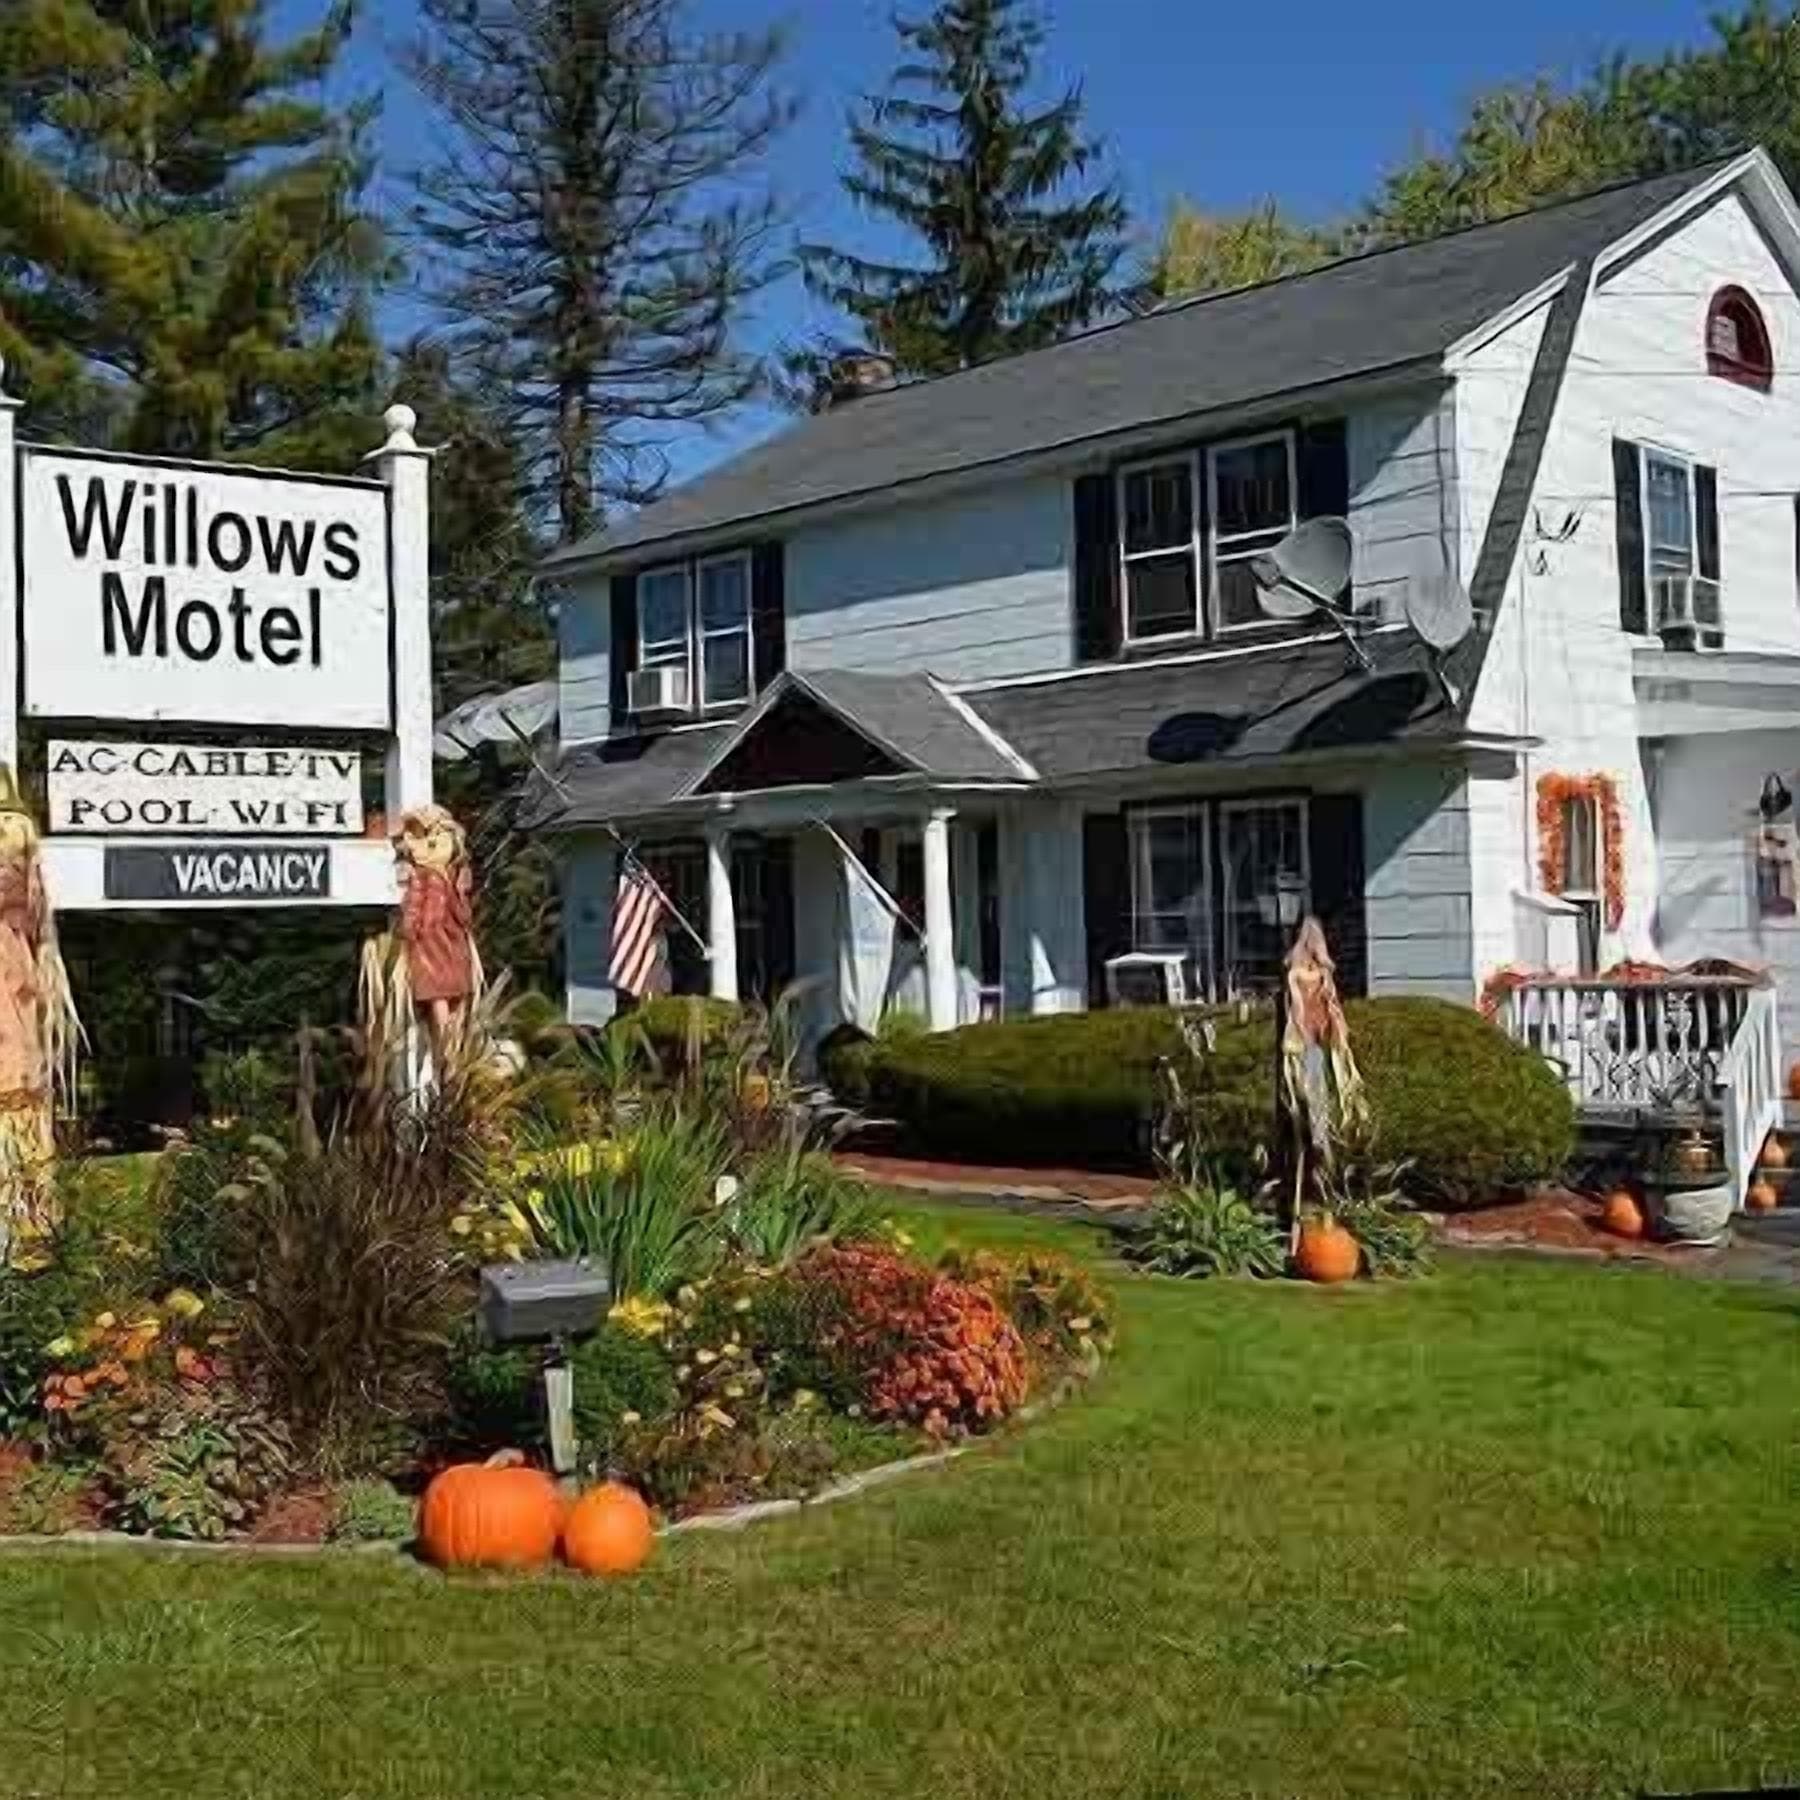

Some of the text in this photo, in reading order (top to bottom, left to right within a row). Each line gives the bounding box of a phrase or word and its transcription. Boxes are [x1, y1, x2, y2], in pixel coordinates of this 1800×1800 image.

[56, 474, 361, 581] Willows
[101, 572, 321, 667] Motel
[301, 753, 360, 780] TV
[68, 799, 208, 825] POOL
[172, 852, 325, 893] VACANCY
